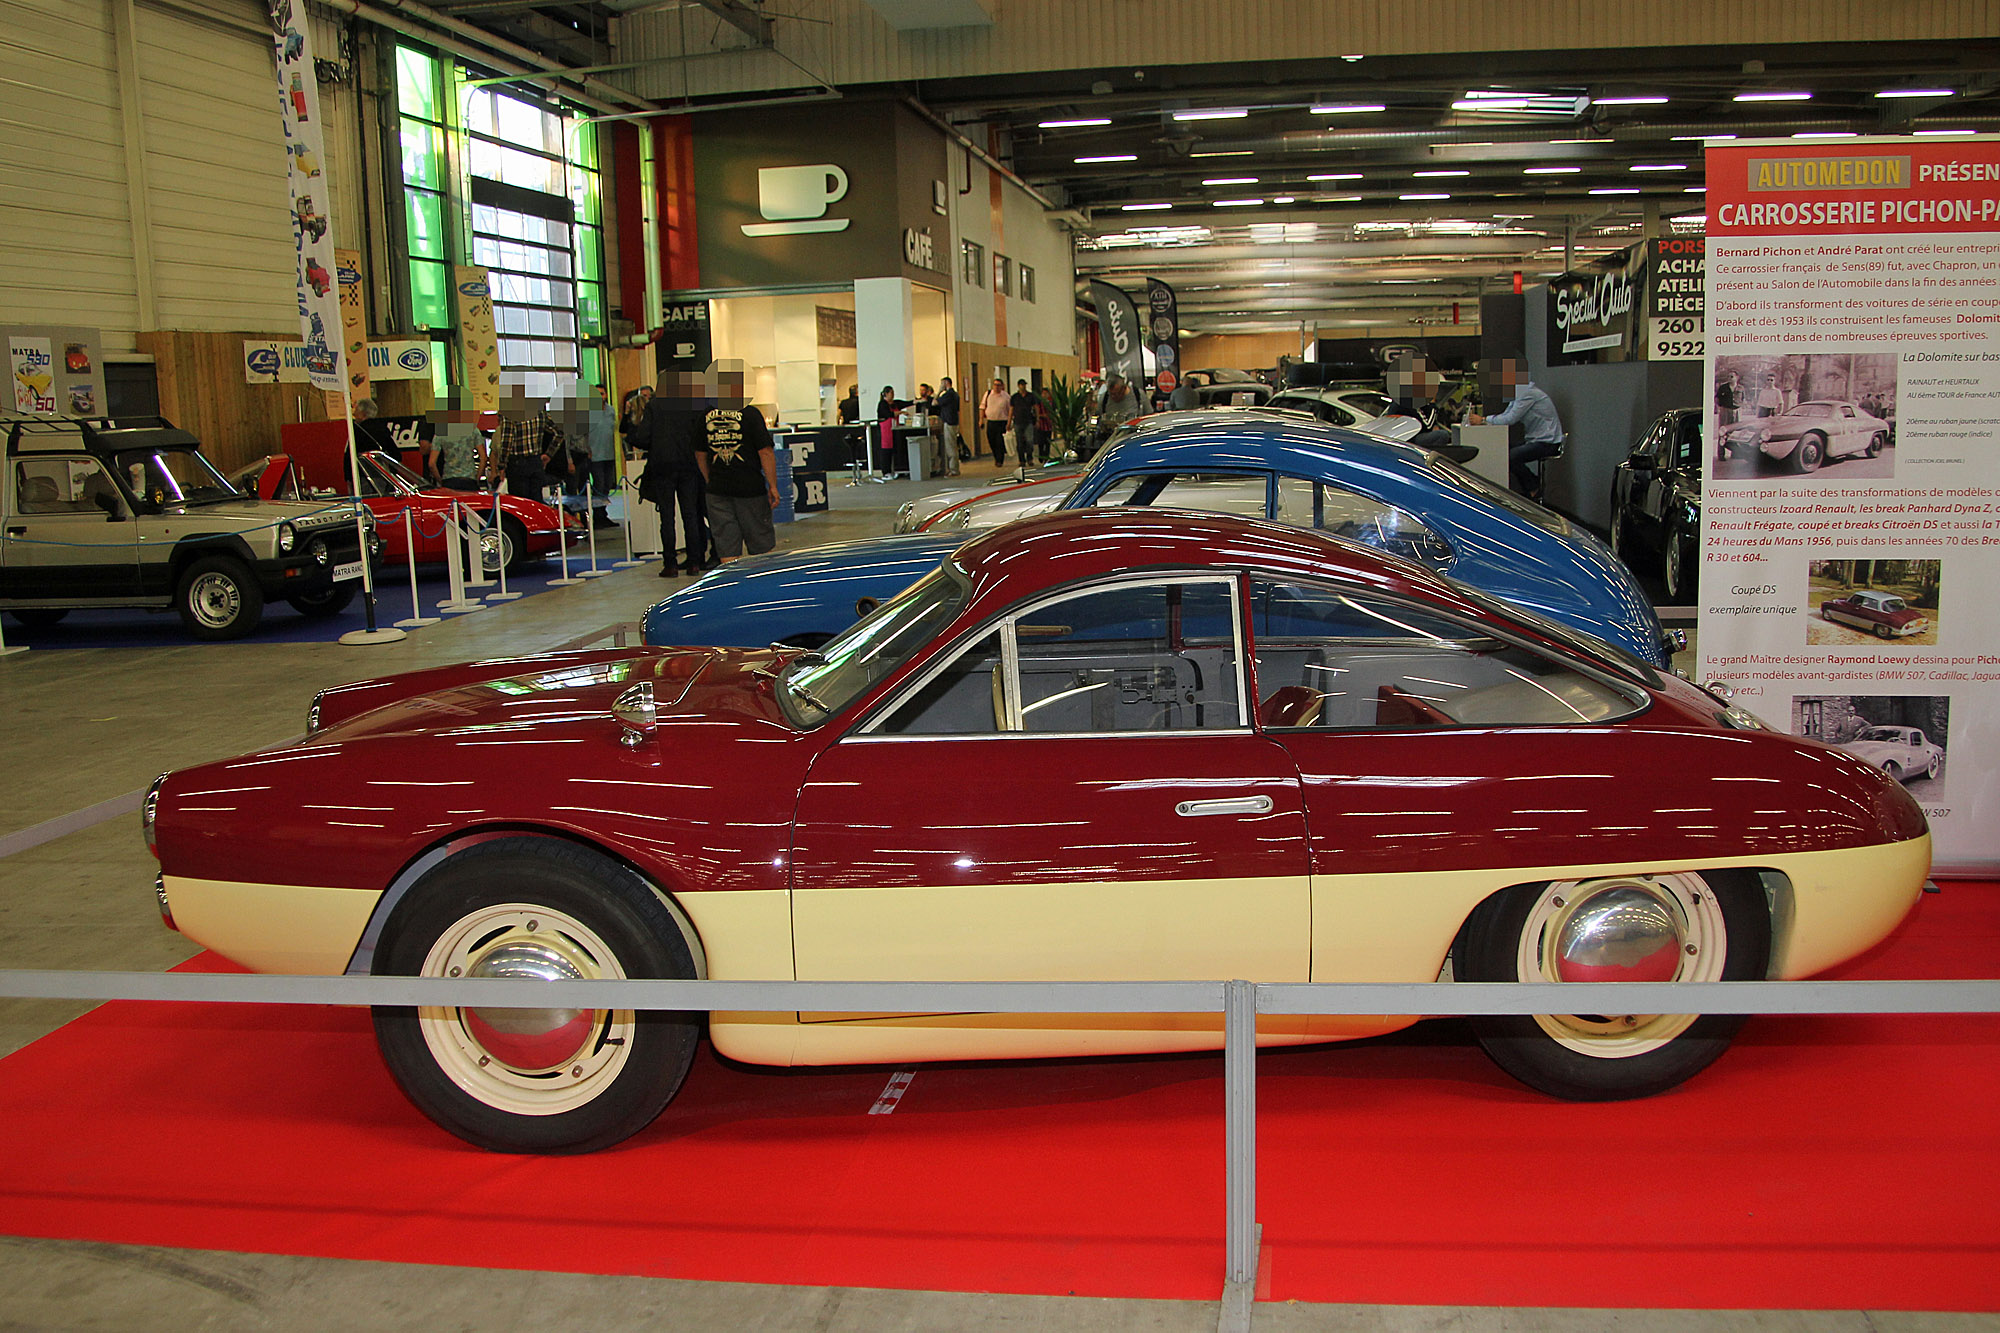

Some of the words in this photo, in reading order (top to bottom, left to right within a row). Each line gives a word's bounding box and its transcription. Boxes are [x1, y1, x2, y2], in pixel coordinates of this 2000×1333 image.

[1757, 159, 1901, 188] AUTOMEDON
[1919, 160, 2000, 182] PRÉSEN
[1718, 201, 1876, 227] CARROSSERIE
[904, 226, 933, 270] CAFÉ
[1658, 239, 1705, 254] PORS
[1716, 246, 1760, 258] Bernard
[1762, 246, 1801, 257] Pichon
[1804, 246, 1814, 256] et
[1816, 245, 1852, 256] André
[1854, 245, 1883, 255] Parat
[1885, 245, 1904, 254] ont
[1906, 244, 1930, 254] créé
[1933, 243, 1954, 254] leur
[1657, 259, 1705, 274] ACHA
[1716, 263, 1729, 274] Ce
[1731, 263, 1780, 274] carrossier
[1782, 262, 1821, 275] français
[1825, 261, 1839, 272] de
[1841, 260, 1885, 273] Sens(89)
[1887, 260, 1904, 272] fut,
[1906, 262, 1930, 271] avec
[1932, 260, 1979, 272] Chapron,
[1982, 261, 1996, 270] un
[1657, 278, 1705, 292] ATELI
[1716, 280, 1754, 292] présent
[1755, 281, 1769, 290] au
[1771, 278, 1800, 290] Salon
[1802, 278, 1815, 289] de
[1817, 277, 1882, 289] l'Automobile
[1884, 277, 1909, 288] dans
[1911, 276, 1920, 287] la
[1922, 276, 1936, 287] fin
[1938, 276, 1957, 287] des
[1958, 276, 1996, 287] années
[1556, 275, 1599, 340] Spécial
[1600, 271, 1632, 327] Auto
[1657, 293, 1704, 312] PIÈCE
[1716, 299, 1757, 311] D'abord
[1760, 299, 1771, 310] ils
[1773, 298, 1843, 310] transforment
[1844, 297, 1863, 309] des
[1865, 298, 1909, 308] voitures
[1911, 297, 1925, 308] de
[1927, 297, 1952, 308] série
[1954, 299, 1968, 307] en
[662, 302, 706, 322] CAFÉ
[1658, 318, 1695, 334] 260
[1715, 316, 1743, 327] break
[1745, 317, 1756, 327] et
[1758, 316, 1777, 326] dès
[1780, 315, 1804, 326] 1953
[1806, 315, 1817, 326] ils
[1819, 315, 1883, 326] construisent
[1886, 313, 1900, 324] les
[1902, 313, 1951, 324] fameuses
[1716, 333, 1731, 345] qui
[1733, 332, 1781, 343] brilleront
[1782, 331, 1807, 342] dans
[1808, 331, 1822, 342] de
[1824, 330, 1887, 342] nombreuses
[1889, 330, 1937, 343] épreuves
[1939, 330, 1988, 342] sportives.
[12, 348, 41, 357] MATRA
[1657, 341, 1705, 357] 9522
[1903, 352, 1915, 362] La
[1917, 351, 1963, 362] Dolomite
[1965, 353, 1980, 362] sur
[284, 346, 308, 368] CLUB
[1708, 488, 1757, 498] Viennent
[1759, 490, 1777, 501] par
[1779, 487, 1788, 498] la
[1791, 487, 1817, 498] suite
[1819, 487, 1838, 498] des
[1840, 487, 1927, 498] transformations
[1929, 487, 1943, 497] de
[1946, 486, 1992, 497] modèles
[1707, 505, 1777, 515] constructeurs
[1779, 503, 1813, 514] Izoard
[1814, 503, 1856, 515] Renault,
[1859, 503, 1873, 513] les
[1875, 503, 1905, 513] break
[1906, 503, 1952, 513] Panhard
[1953, 503, 1981, 515] Dyna
[1982, 503, 1992, 514] Z,
[1709, 520, 1752, 531] Renault
[1753, 520, 1795, 532] Frégate,
[1797, 520, 1830, 532] coupé
[1831, 520, 1842, 530] et
[1844, 519, 1880, 530] breaks
[1882, 519, 1921, 530] Citroën
[1922, 519, 1938, 529] DS
[1940, 520, 1951, 530] et
[1953, 519, 1979, 529] aussi
[1981, 519, 1992, 529] la
[1706, 536, 1720, 546] 24
[1722, 536, 1757, 547] heures
[1758, 535, 1772, 546] du
[1773, 536, 1803, 546] Mans
[1806, 536, 1833, 547] 1956,
[1836, 535, 1858, 548] puis
[1860, 535, 1886, 546] dans
[1888, 535, 1903, 546] les
[1904, 535, 1943, 546] années
[1946, 535, 1959, 545] 70
[1960, 535, 1979, 546] des
[1706, 552, 1714, 562] R
[1715, 552, 1729, 562] 30
[1730, 553, 1741, 562] et
[1730, 584, 1761, 597] Coupé
[1762, 584, 1776, 594] DS
[1708, 604, 1761, 617] exemplaire
[1762, 604, 1797, 616] unique
[1706, 654, 1718, 664] Le
[1720, 654, 1747, 667] grand
[1749, 654, 1781, 664] Maître
[1782, 654, 1825, 666] designer
[1827, 654, 1875, 666] Raymond
[1877, 654, 1911, 666] Loewy
[1912, 654, 1949, 664] dessina
[1951, 657, 1975, 666] pour
[1705, 670, 1750, 683] plusieurs
[1752, 669, 1795, 680] modèles
[1797, 670, 1873, 682] avant-gardistes
[1876, 670, 1906, 681] (BMW
[1907, 670, 1927, 681] 507,
[1928, 670, 1969, 681] Cadillac,
[1932, 808, 1951, 818] 507
